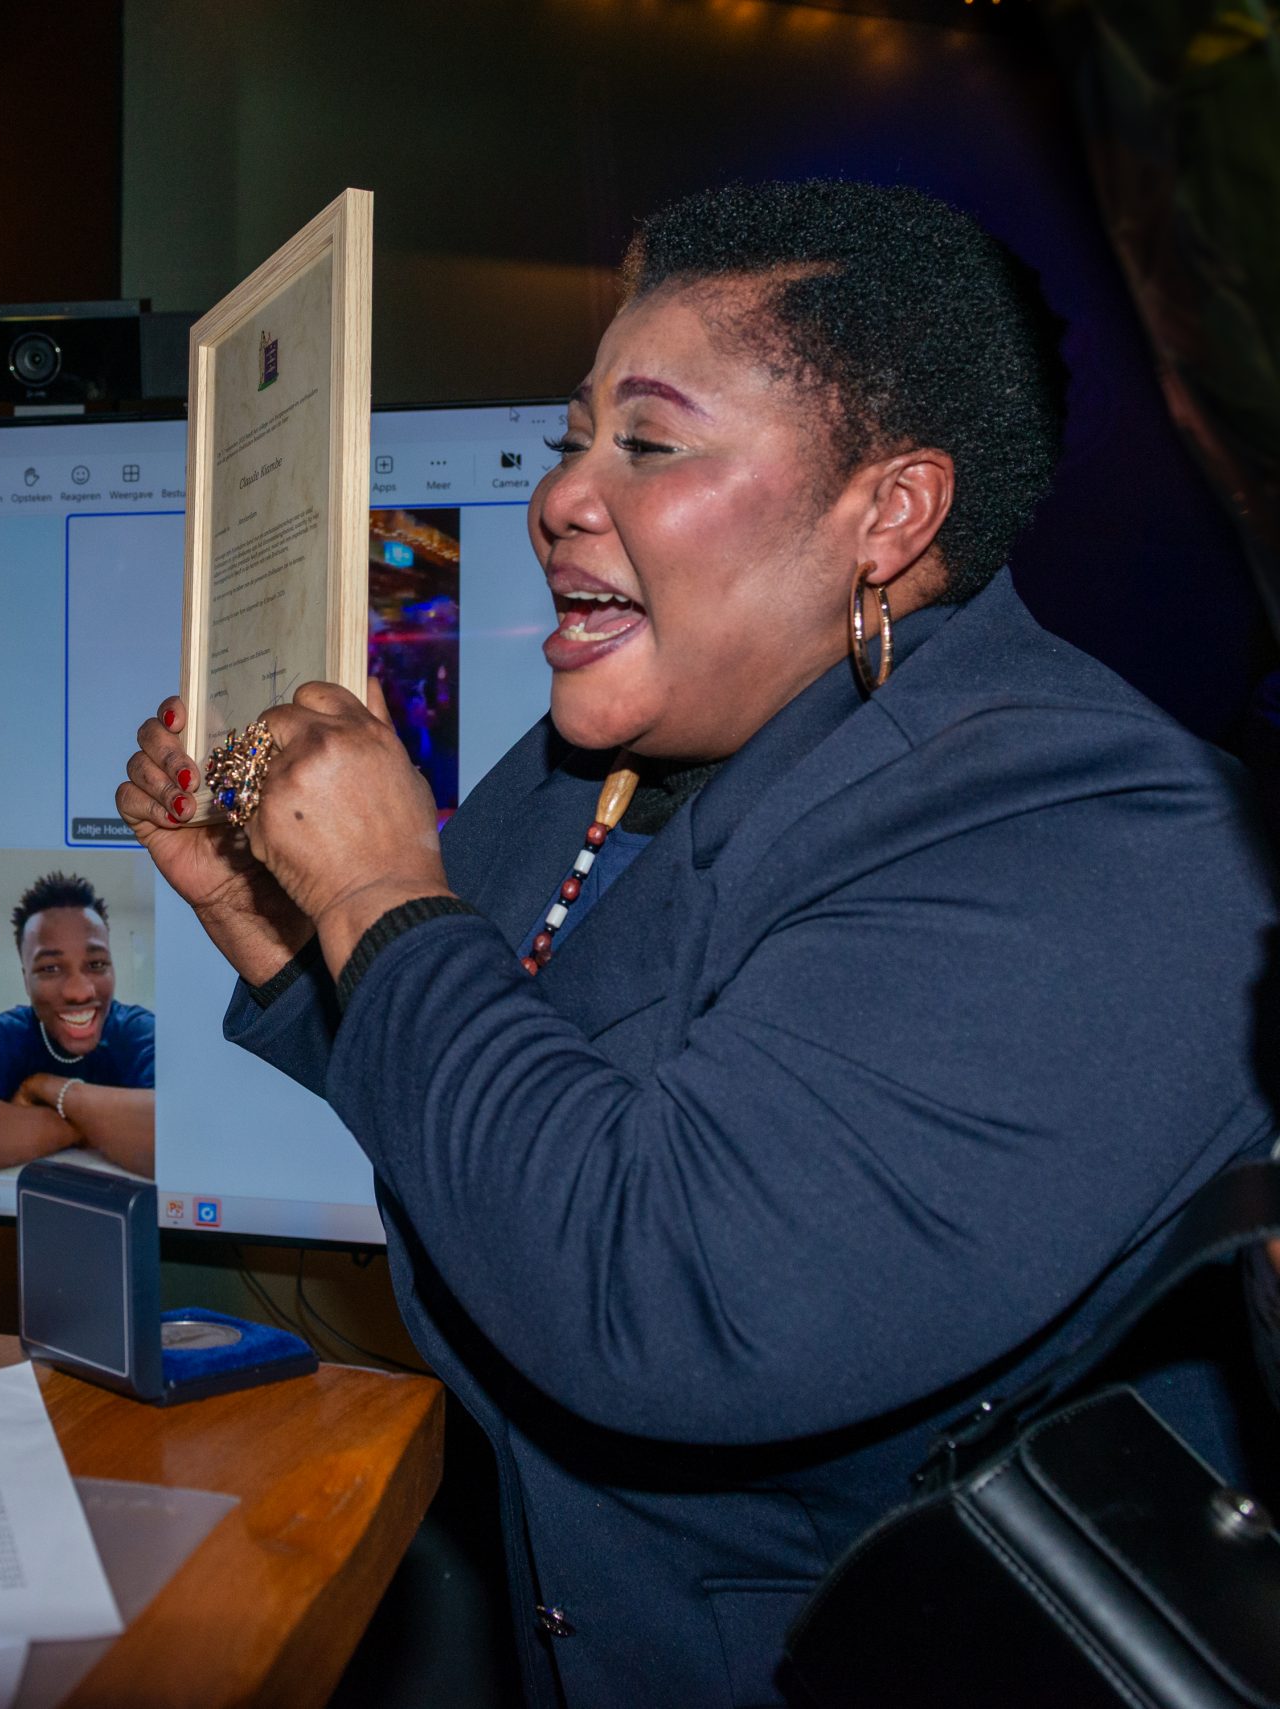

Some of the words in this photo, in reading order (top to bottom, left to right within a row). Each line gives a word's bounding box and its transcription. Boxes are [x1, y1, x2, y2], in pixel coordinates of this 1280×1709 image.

[372, 482, 397, 493] Apps
[426, 481, 451, 490] Meer
[492, 479, 530, 489] Camera
[11, 493, 52, 504] Opsteken
[60, 491, 101, 503] Reageren
[109, 490, 153, 502] Weergave
